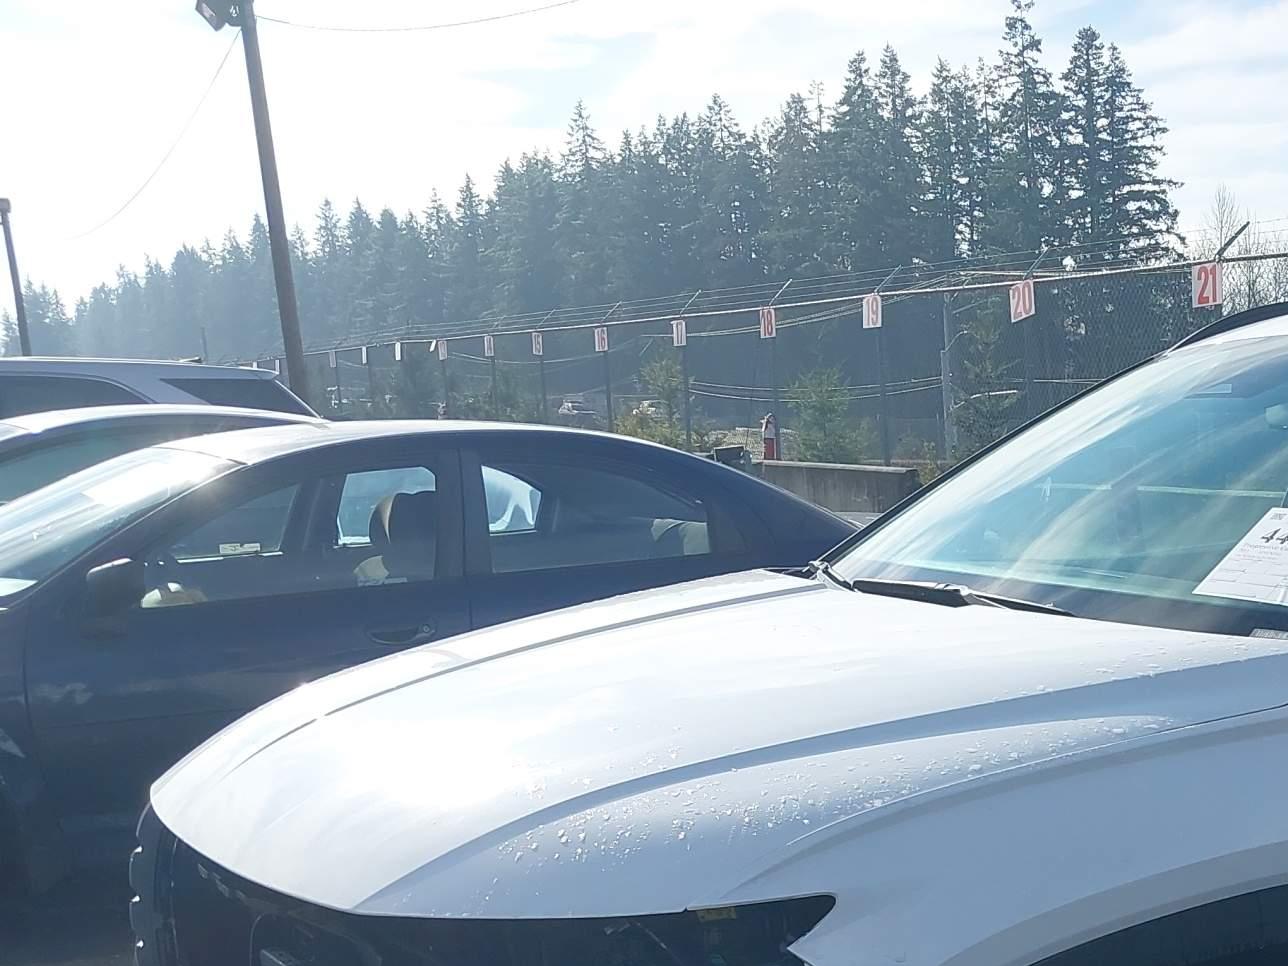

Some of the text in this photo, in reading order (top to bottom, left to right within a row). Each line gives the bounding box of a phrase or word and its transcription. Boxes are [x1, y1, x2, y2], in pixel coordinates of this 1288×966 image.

[1197, 264, 1217, 305] 21
[865, 296, 879, 327] 19
[1012, 281, 1033, 320] 20
[675, 320, 685, 345] 17
[761, 308, 774, 337] 18
[596, 327, 607, 351] 16
